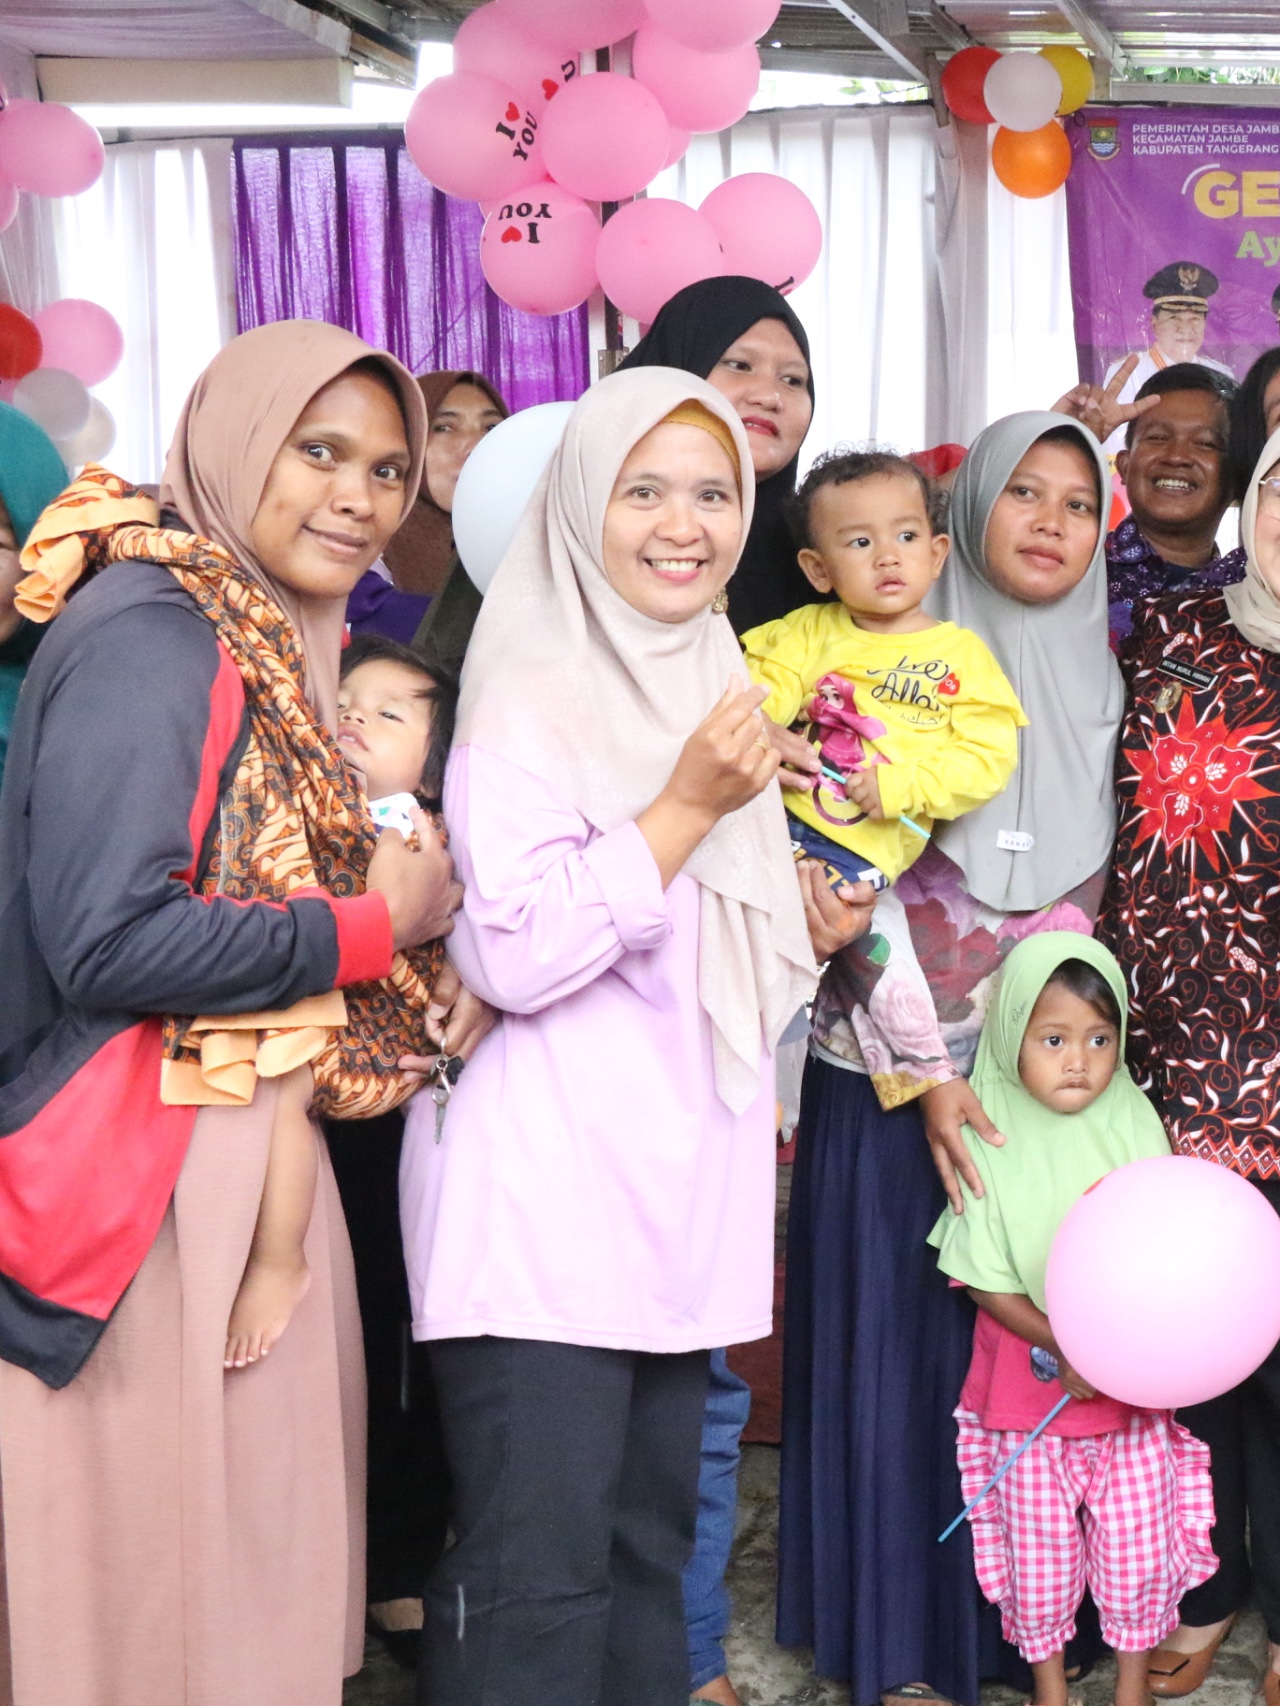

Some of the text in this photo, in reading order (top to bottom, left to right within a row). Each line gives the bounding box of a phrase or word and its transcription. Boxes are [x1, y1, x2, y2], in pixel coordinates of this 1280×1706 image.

[495, 122, 516, 141] I
[513, 110, 538, 161] YOU
[1132, 124, 1209, 134] PEMERINTAH
[1212, 124, 1244, 134] DESA
[1132, 134, 1249, 144] KECAMATAN JAMBE
[1133, 144, 1279, 155] KABUPATEN TANGERANG
[498, 202, 552, 221] YOU
[527, 222, 541, 245] I
